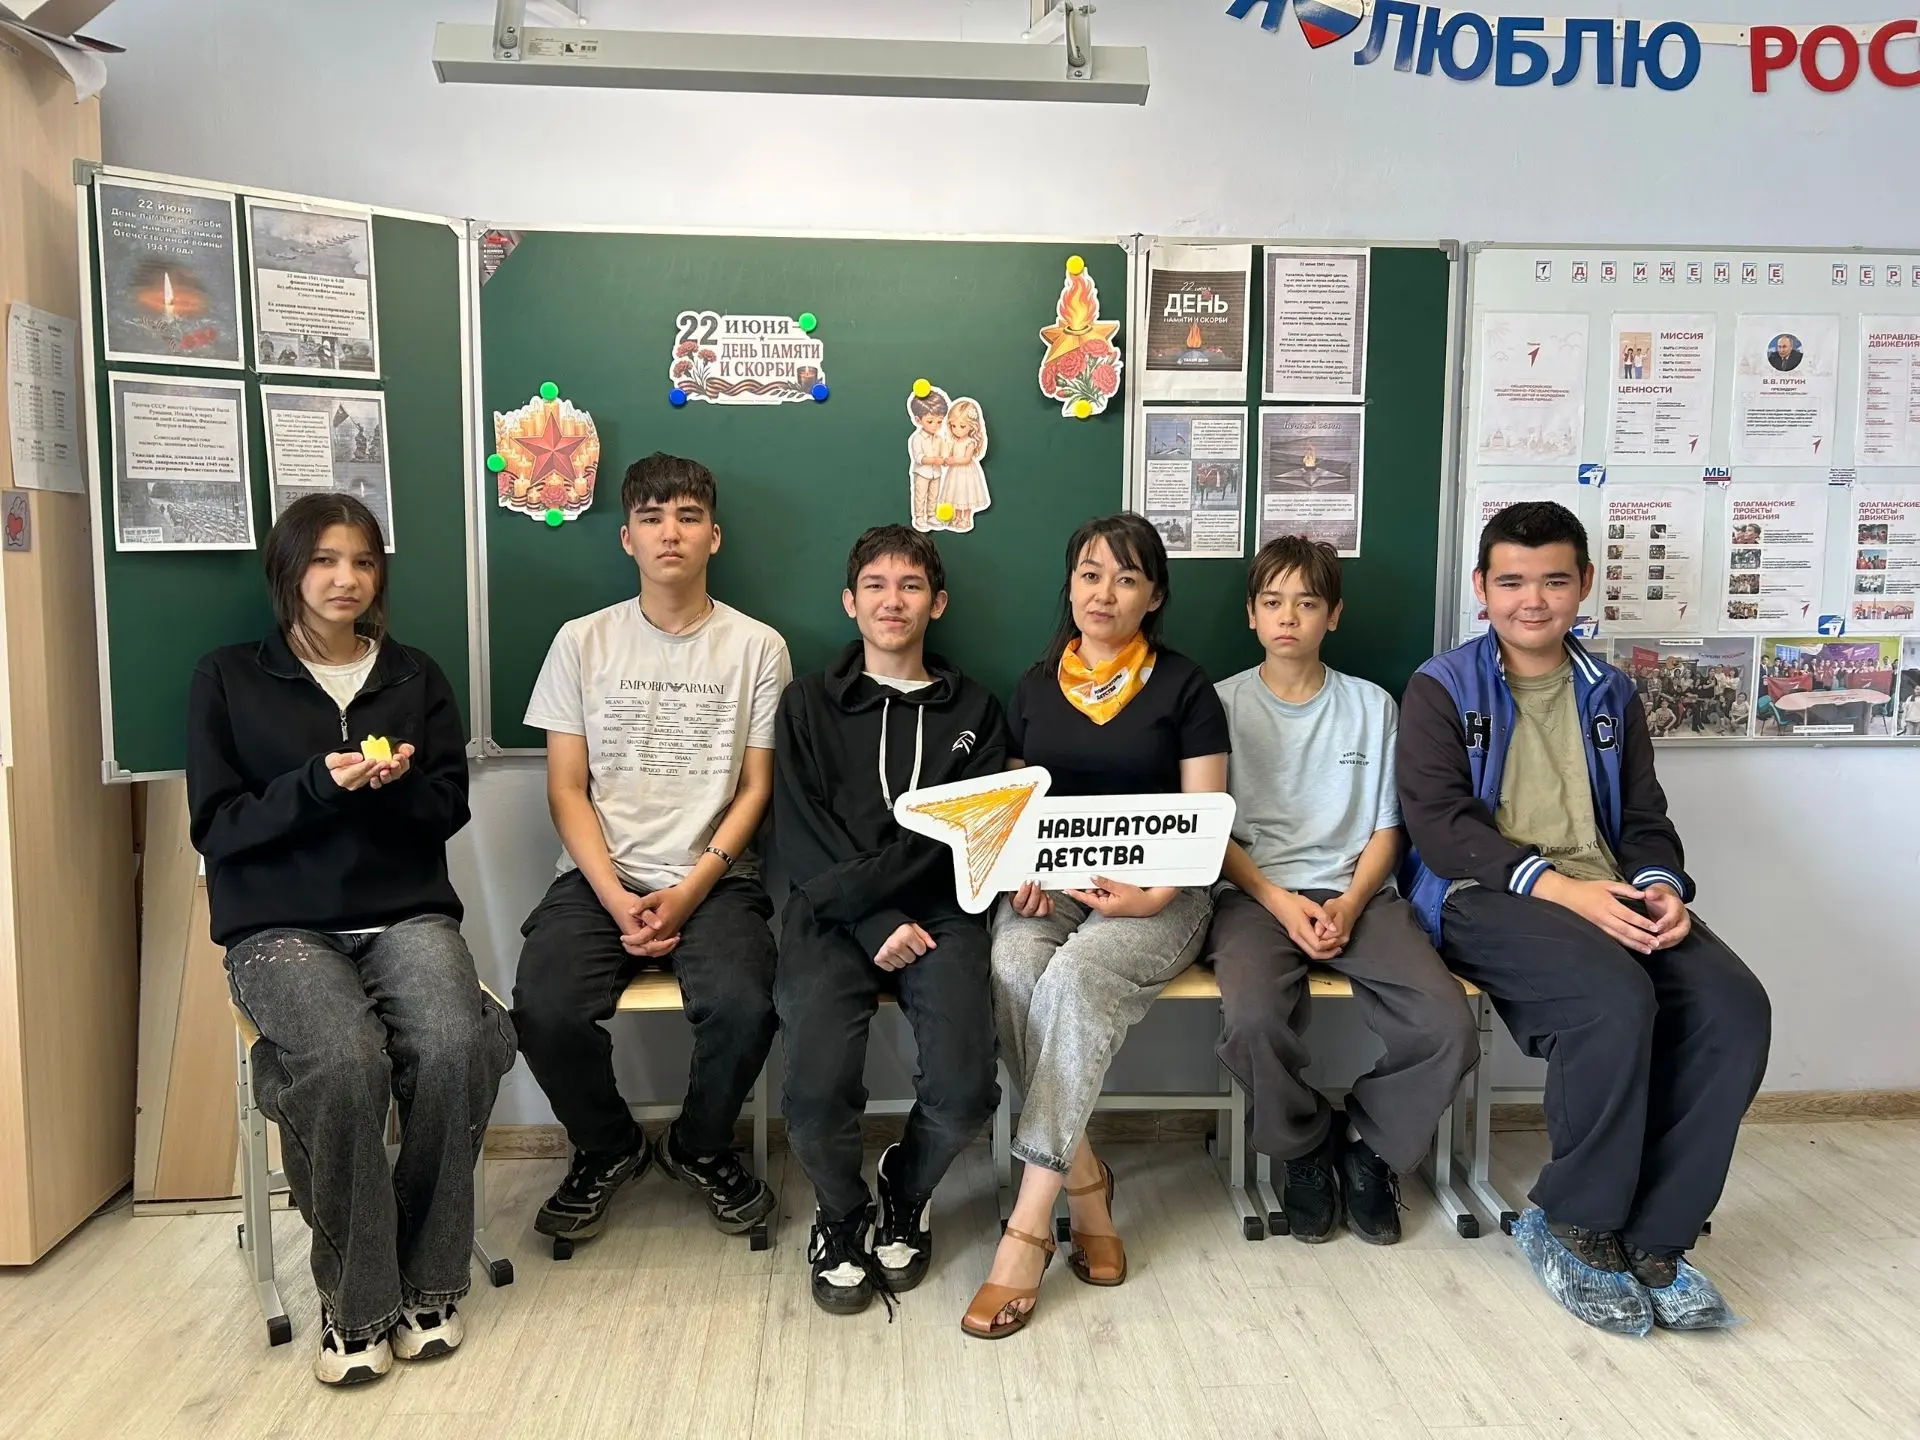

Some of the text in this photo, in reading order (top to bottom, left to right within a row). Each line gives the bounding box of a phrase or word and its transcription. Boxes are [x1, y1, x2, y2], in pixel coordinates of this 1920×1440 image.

[1354, 0, 1701, 91] ЛЮБЛЮ
[111, 208, 136, 218] День
[138, 199, 192, 214] 22 июня
[146, 242, 168, 252] 1941
[1180, 281, 1195, 291] 22
[1164, 293, 1228, 317] ДЕНЬ
[679, 314, 789, 346] 22 ИЮНЯ
[1660, 332, 1704, 340] МИССИЯ
[721, 344, 820, 359] ДЕНЬ ПАМЯТИ
[720, 362, 795, 377] И СКОРБИ
[1618, 386, 1672, 394] ЦЕННОСТИ
[1705, 467, 1729, 477] МЫ
[620, 680, 724, 694] EMPORIO ARMANI
[1096, 685, 1116, 700] ДЕТСТВА
[1037, 814, 1198, 839] НАВИГАТОРЫ
[1035, 844, 1145, 872] ДЕТСТВА
